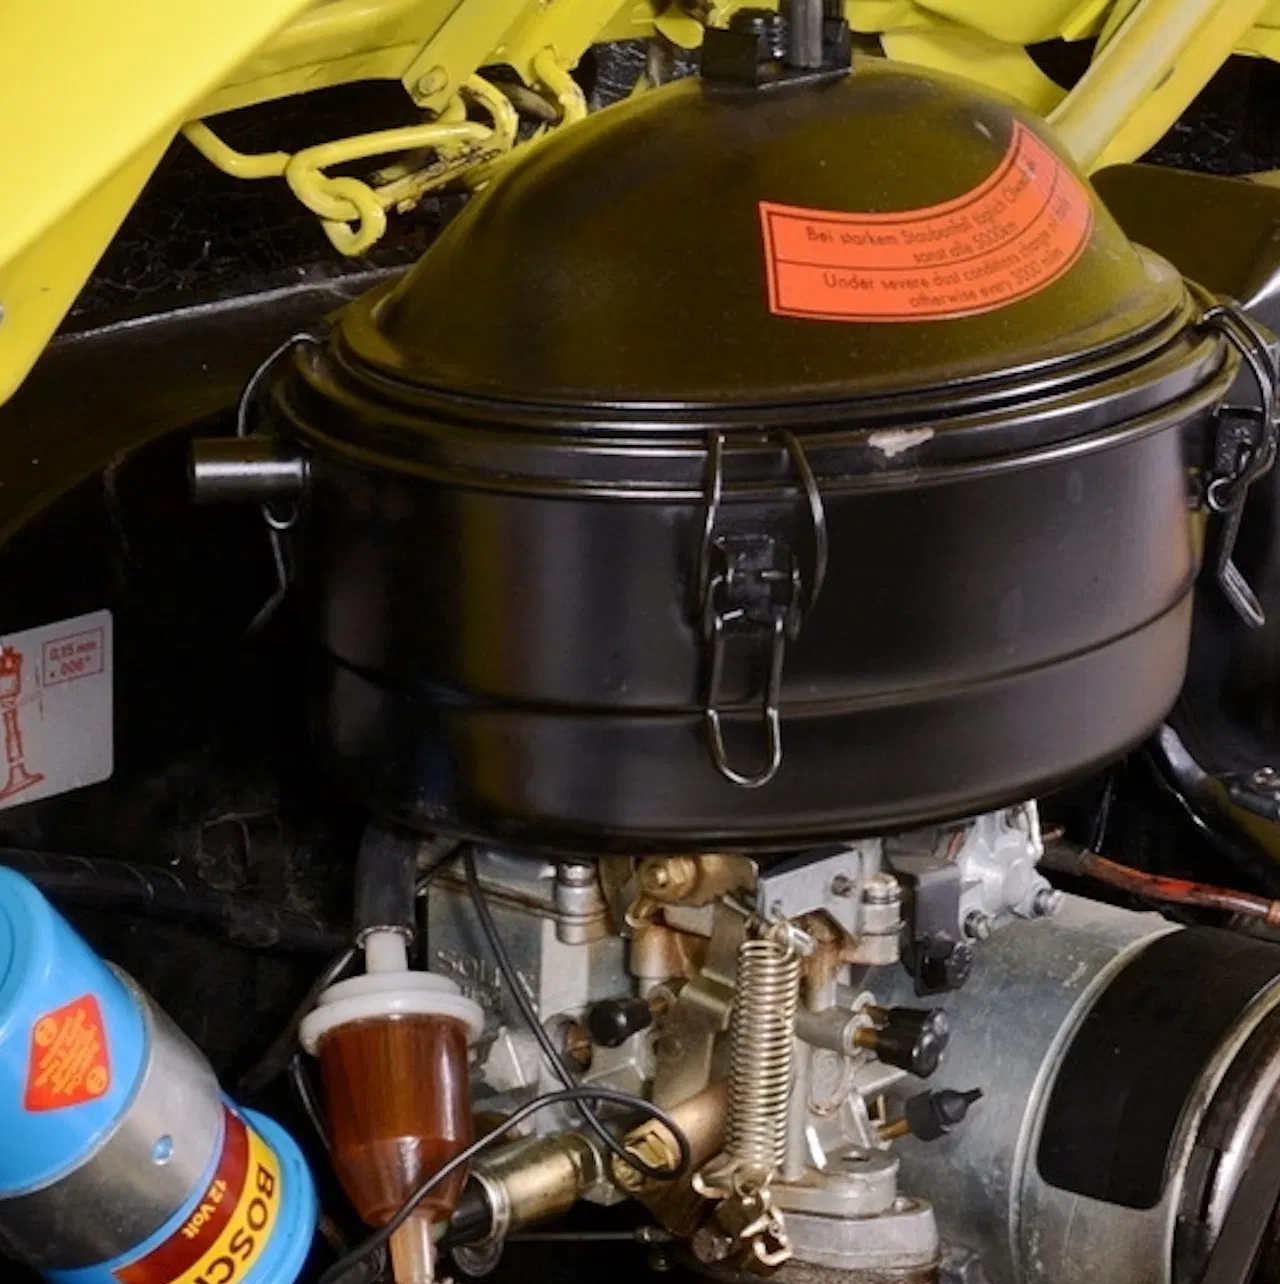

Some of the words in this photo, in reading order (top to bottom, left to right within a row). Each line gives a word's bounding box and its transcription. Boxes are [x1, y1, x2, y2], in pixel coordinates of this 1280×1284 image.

[806, 225, 834, 243] Bei
[822, 271, 874, 290] Under
[880, 277, 930, 291] severe
[908, 289, 977, 307] otherwise
[979, 279, 1013, 297] every
[208, 1179, 227, 1204] 12
[182, 1203, 217, 1239] Volt
